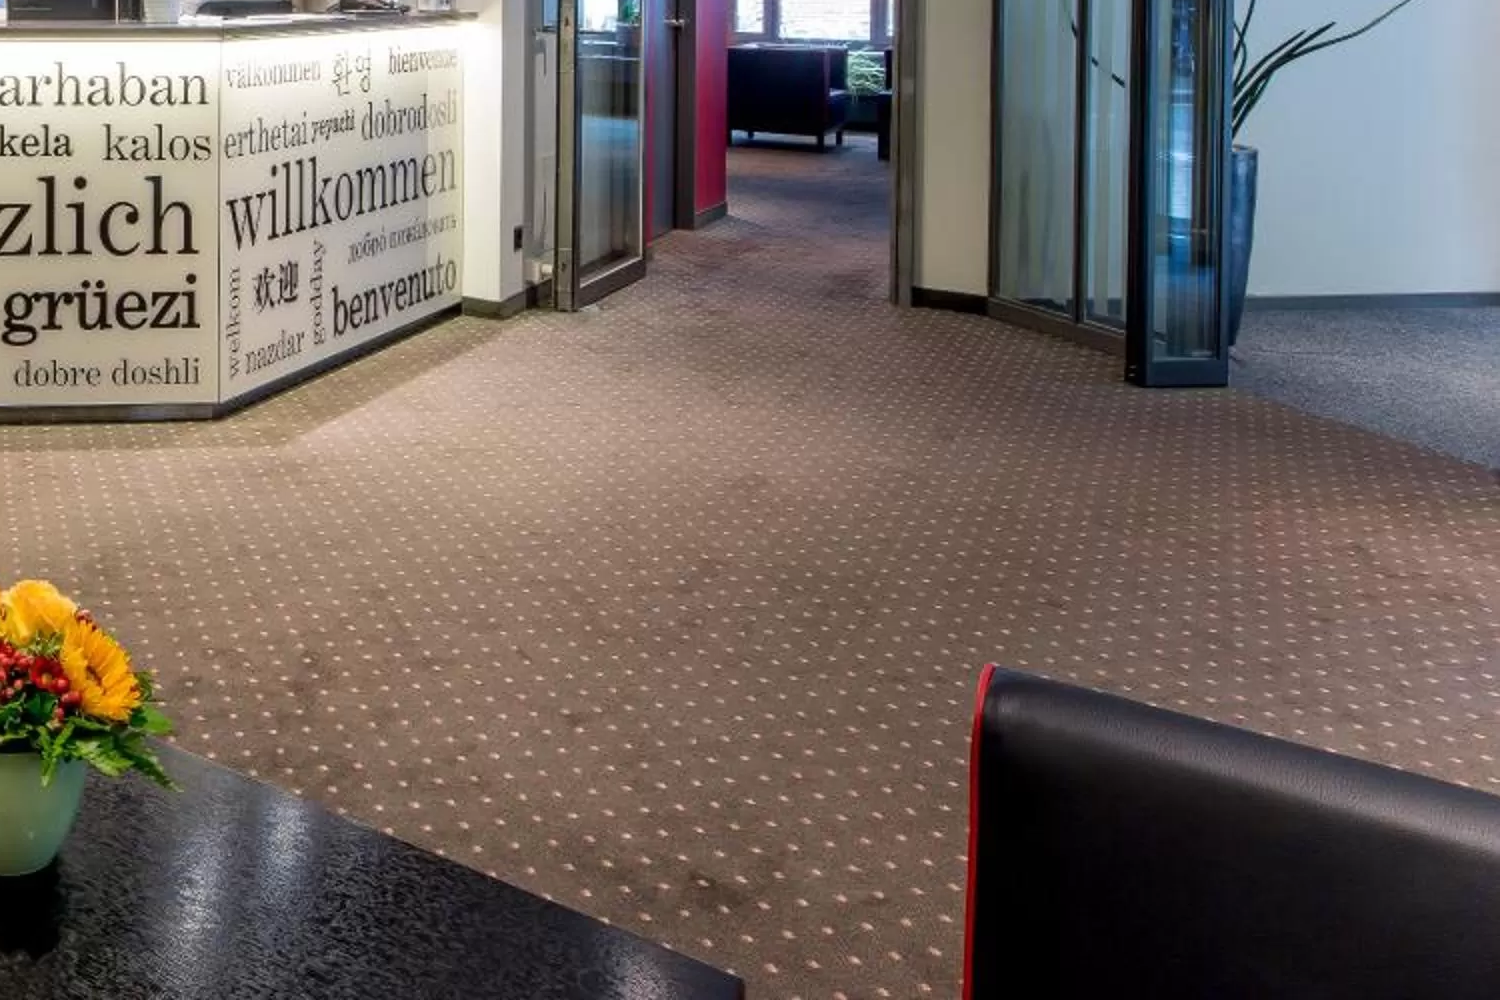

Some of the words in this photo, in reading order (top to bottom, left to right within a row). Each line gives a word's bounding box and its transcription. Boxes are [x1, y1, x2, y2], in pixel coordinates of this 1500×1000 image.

[101, 123, 212, 162] kalos
[226, 149, 457, 251] willkommen
[1, 273, 200, 347] grüezi
[331, 253, 457, 337] benvenuto
[14, 359, 101, 387] dobre
[111, 357, 200, 386] doshli
